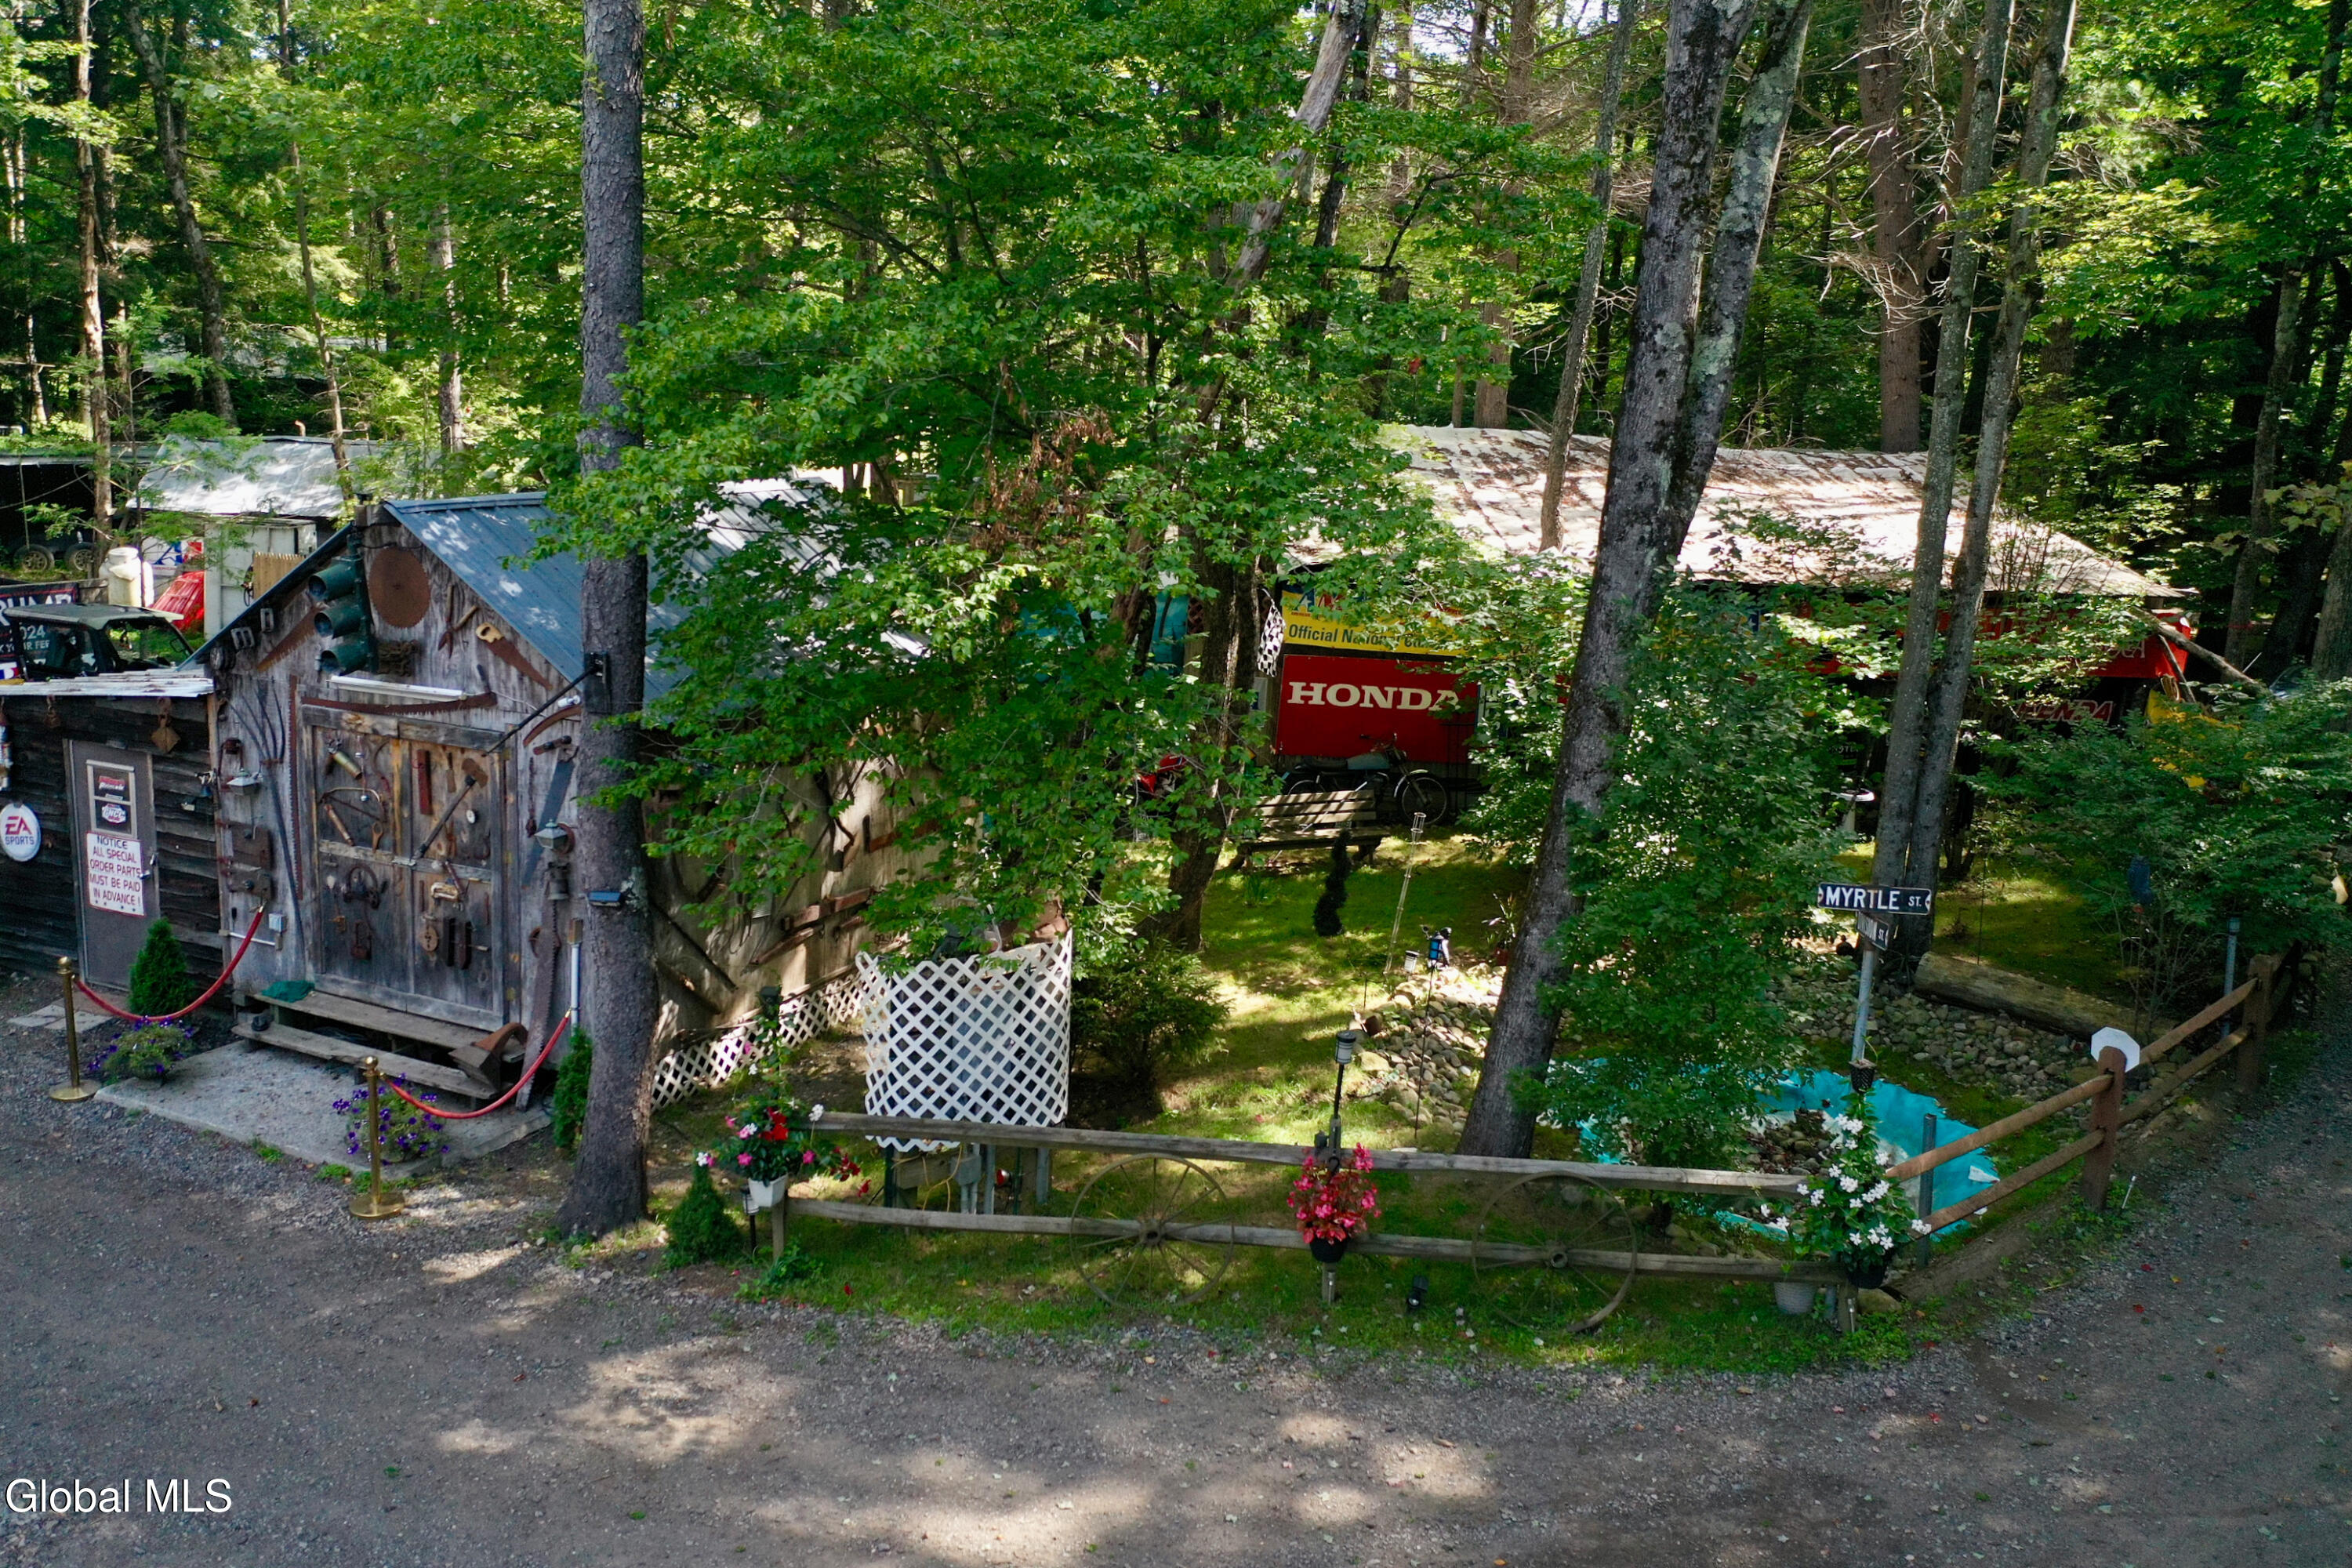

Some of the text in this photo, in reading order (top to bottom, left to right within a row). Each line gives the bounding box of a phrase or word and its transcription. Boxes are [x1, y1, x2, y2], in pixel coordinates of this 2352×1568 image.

[1288, 624, 1338, 642] Official
[1287, 681, 1461, 711] HONDA
[5, 815, 32, 835] EA
[5, 836, 34, 846] SPORTS
[97, 835, 128, 850] NOTICE
[93, 846, 136, 863] ALL SPECIAL
[89, 858, 140, 879] ORDER PARTS
[89, 873, 140, 892] MUST BE PAID
[93, 887, 100, 898] IN
[103, 890, 136, 906] ADVANCE
[1825, 886, 1922, 910] MYRTLE ST.
